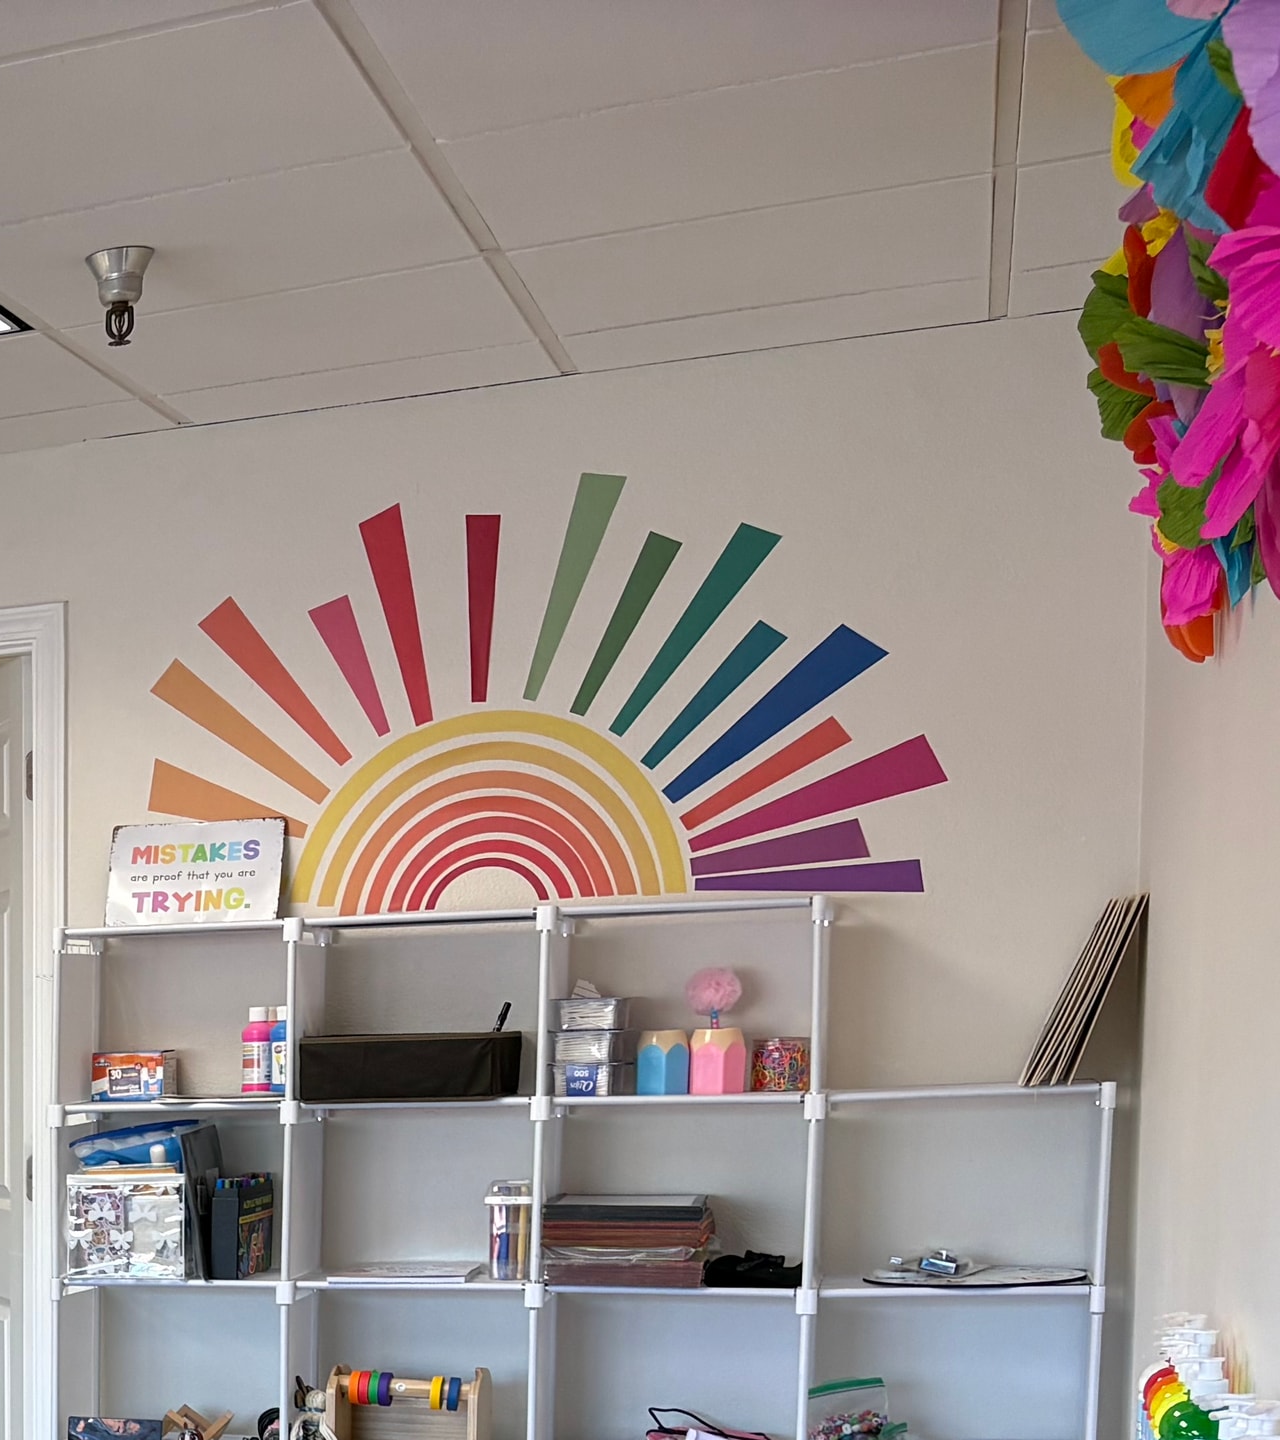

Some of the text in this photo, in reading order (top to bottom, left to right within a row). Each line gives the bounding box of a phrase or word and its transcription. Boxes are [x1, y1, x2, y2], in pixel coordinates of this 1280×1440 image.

[131, 839, 261, 865] MISTAKES
[130, 868, 256, 884] are proof that you are
[131, 887, 251, 914] TRYING.
[110, 1069, 122, 1080] 30
